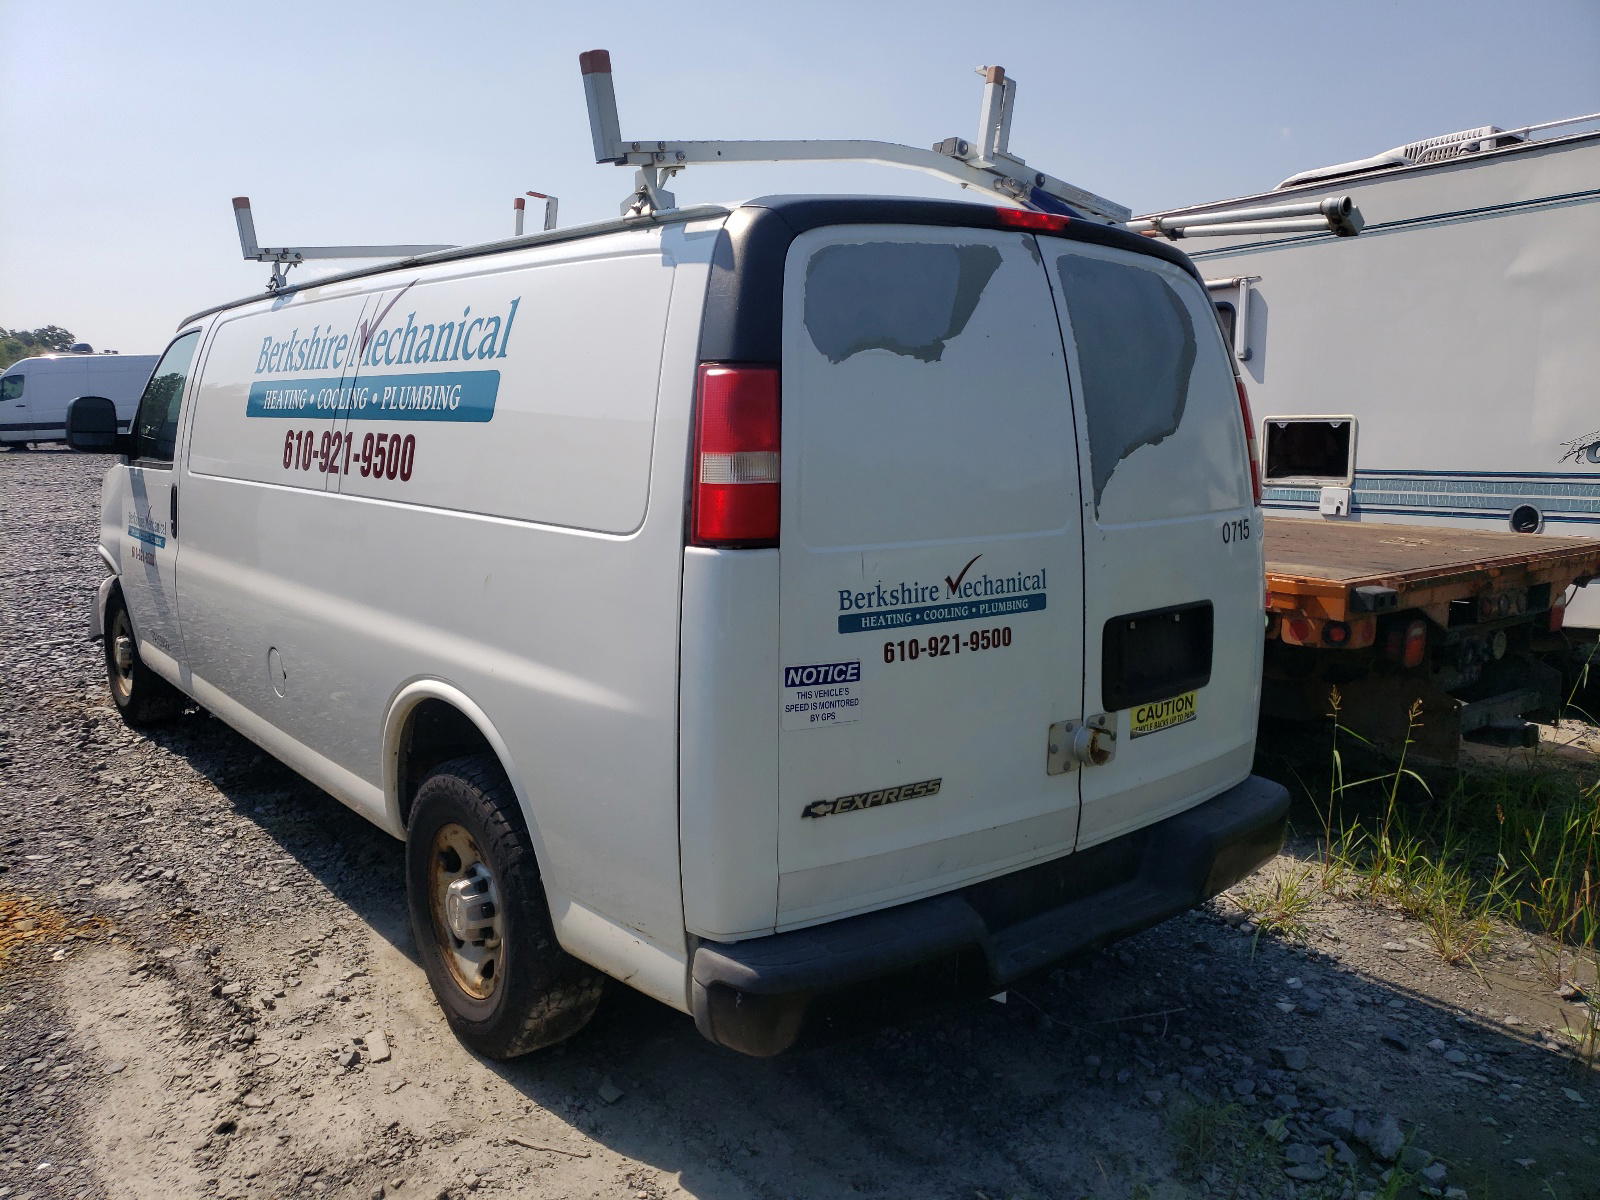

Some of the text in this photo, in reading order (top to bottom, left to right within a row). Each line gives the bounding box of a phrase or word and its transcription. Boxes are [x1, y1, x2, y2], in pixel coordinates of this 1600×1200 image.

[255, 324, 348, 374] Berkshire
[263, 384, 462, 410] HEATING COOLING PLUMBING
[282, 429, 416, 482] 610-921-9500
[1222, 519, 1250, 544] 0715
[838, 582, 939, 611] Berkshire
[861, 600, 1029, 628] HEATING COOLING PLUMBING
[883, 626, 1012, 664] 610-921-9500
[787, 664, 859, 685] NOTICE
[785, 698, 859, 713] SPEED IS MONITORED
[797, 687, 850, 700] THIS VEHICLE'S
[810, 711, 836, 722] BY GPS
[1136, 694, 1194, 723] CAUTION
[834, 779, 942, 814] EXPRESS
